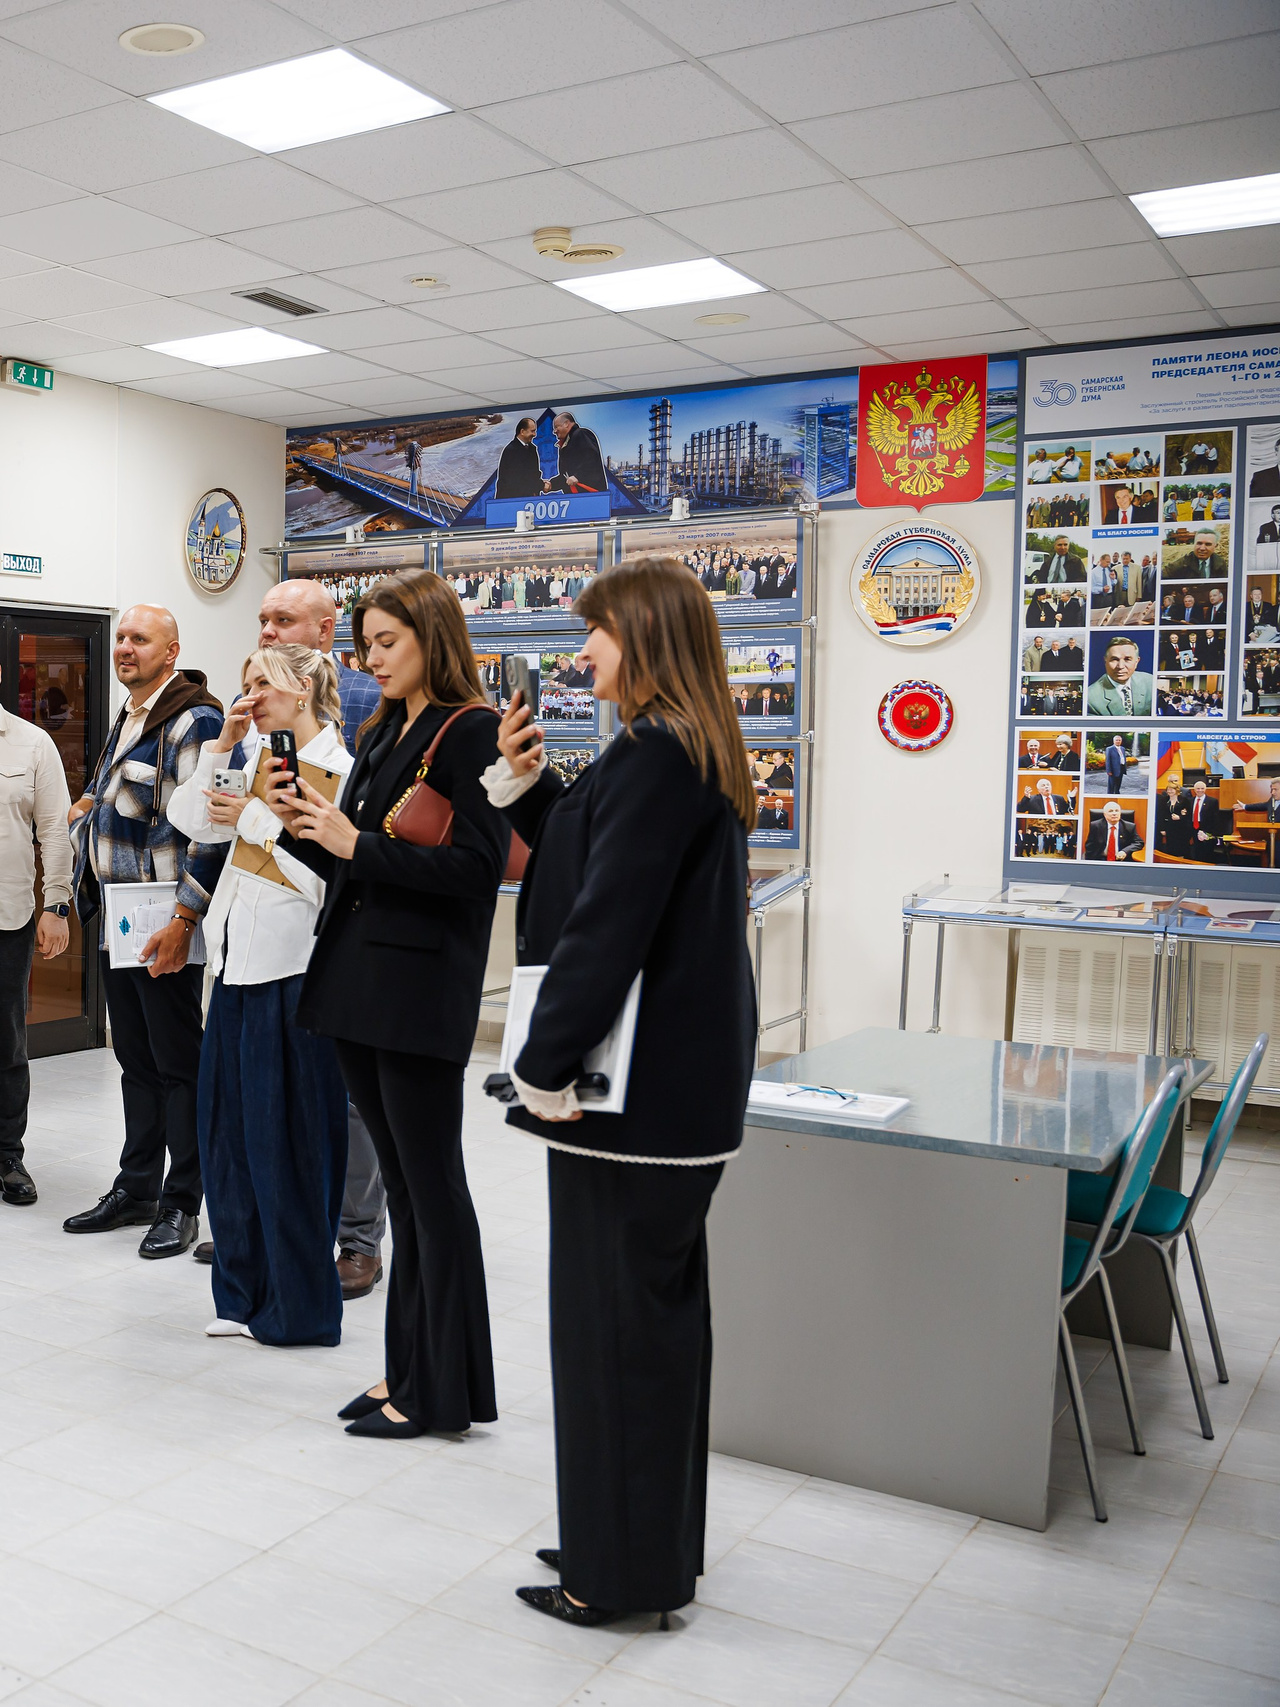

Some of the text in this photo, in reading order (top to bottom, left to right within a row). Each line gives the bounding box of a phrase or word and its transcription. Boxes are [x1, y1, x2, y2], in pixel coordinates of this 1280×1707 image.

[1152, 347, 1280, 366] ПАМЯТИ ЛЕОНА ИОС
[1152, 363, 1245, 379] ПРЕДСЕДАТЕЛЯ
[1081, 376, 1123, 386] САМАРСКАЯ
[1033, 379, 1077, 407] 30
[1081, 384, 1125, 394] ГУБЕРНСКАЯ
[1223, 388, 1255, 396] почетный
[1081, 394, 1101, 403] ДУМА
[1140, 401, 1183, 409] Заслуженный
[1184, 398, 1218, 406] строитель
[1219, 394, 1259, 402] Российской
[1161, 406, 1186, 414] заслуги
[1192, 404, 1223, 412] развитии
[862, 526, 972, 570] САМАРСКАЯ ГУБЕРНСКАЯ ДУМА
[3, 555, 40, 573] ВЫХОД
